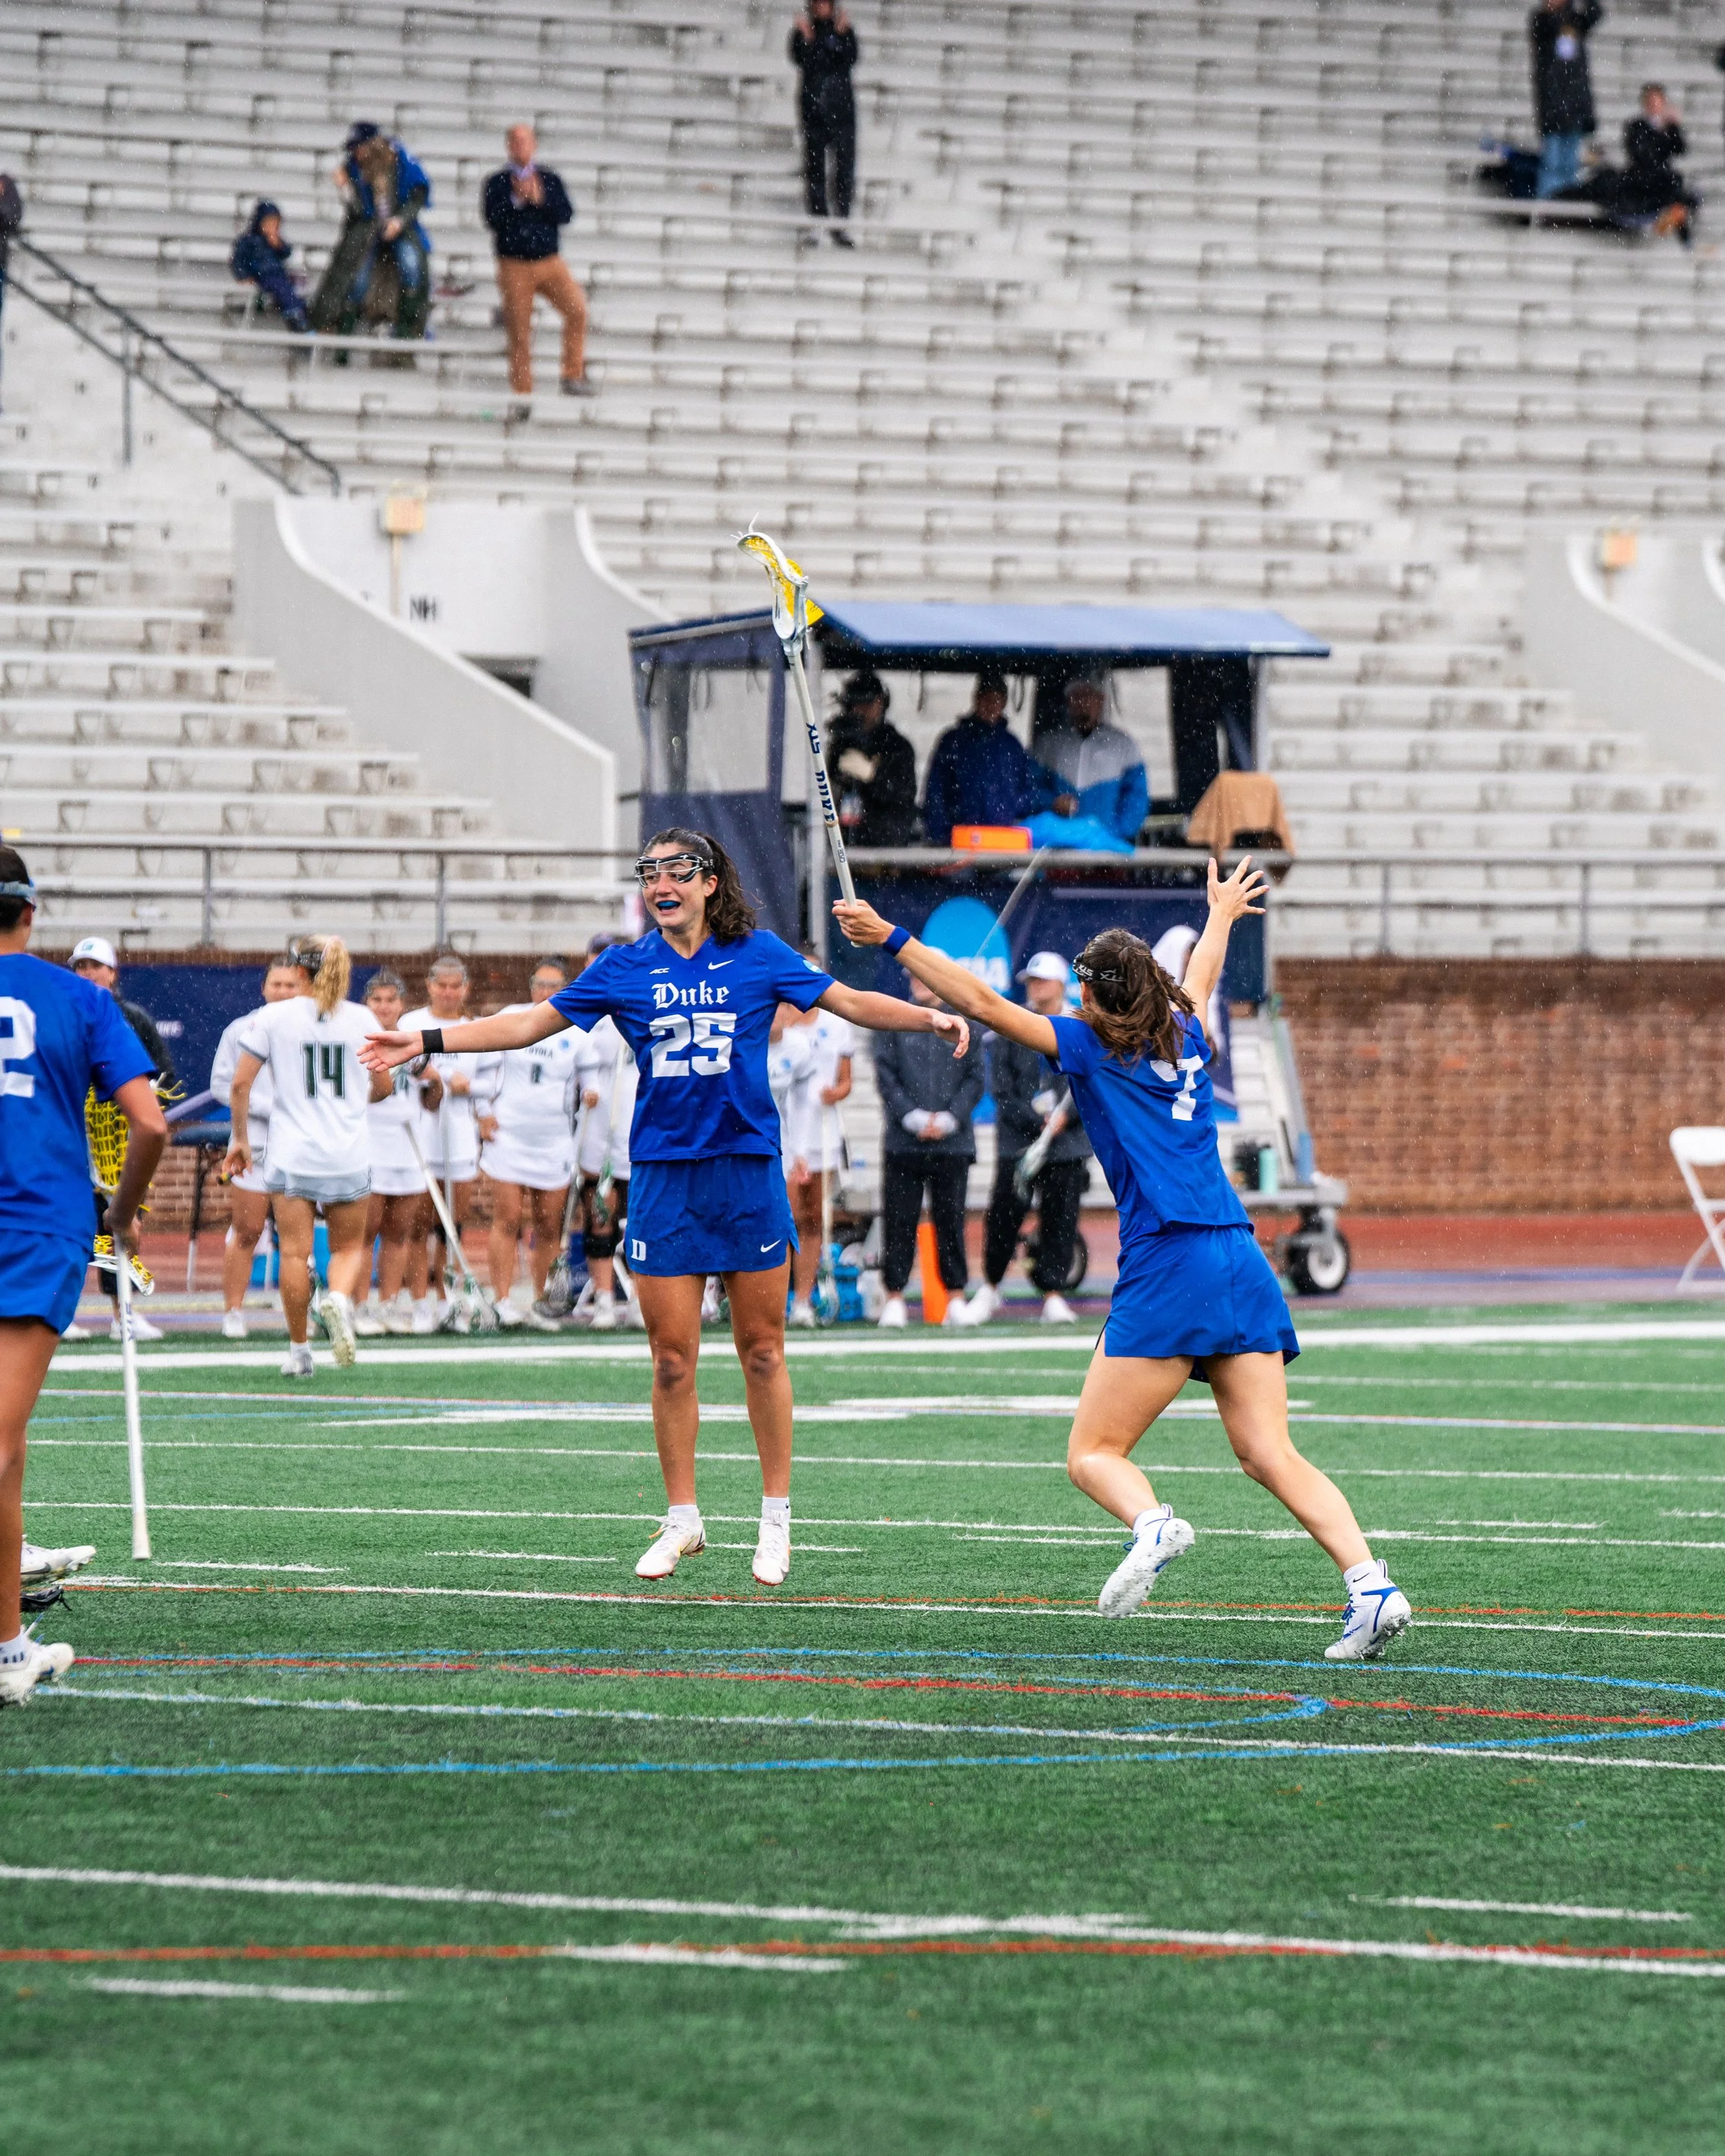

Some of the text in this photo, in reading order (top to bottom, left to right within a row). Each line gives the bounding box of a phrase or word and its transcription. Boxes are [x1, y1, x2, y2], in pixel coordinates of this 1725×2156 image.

[806, 722, 820, 754] STX
[651, 980, 730, 1010] Duke
[649, 1012, 738, 1078] 25
[299, 1040, 345, 1099] 14
[1150, 1055, 1204, 1121] 7
[631, 1238, 647, 1261] D
